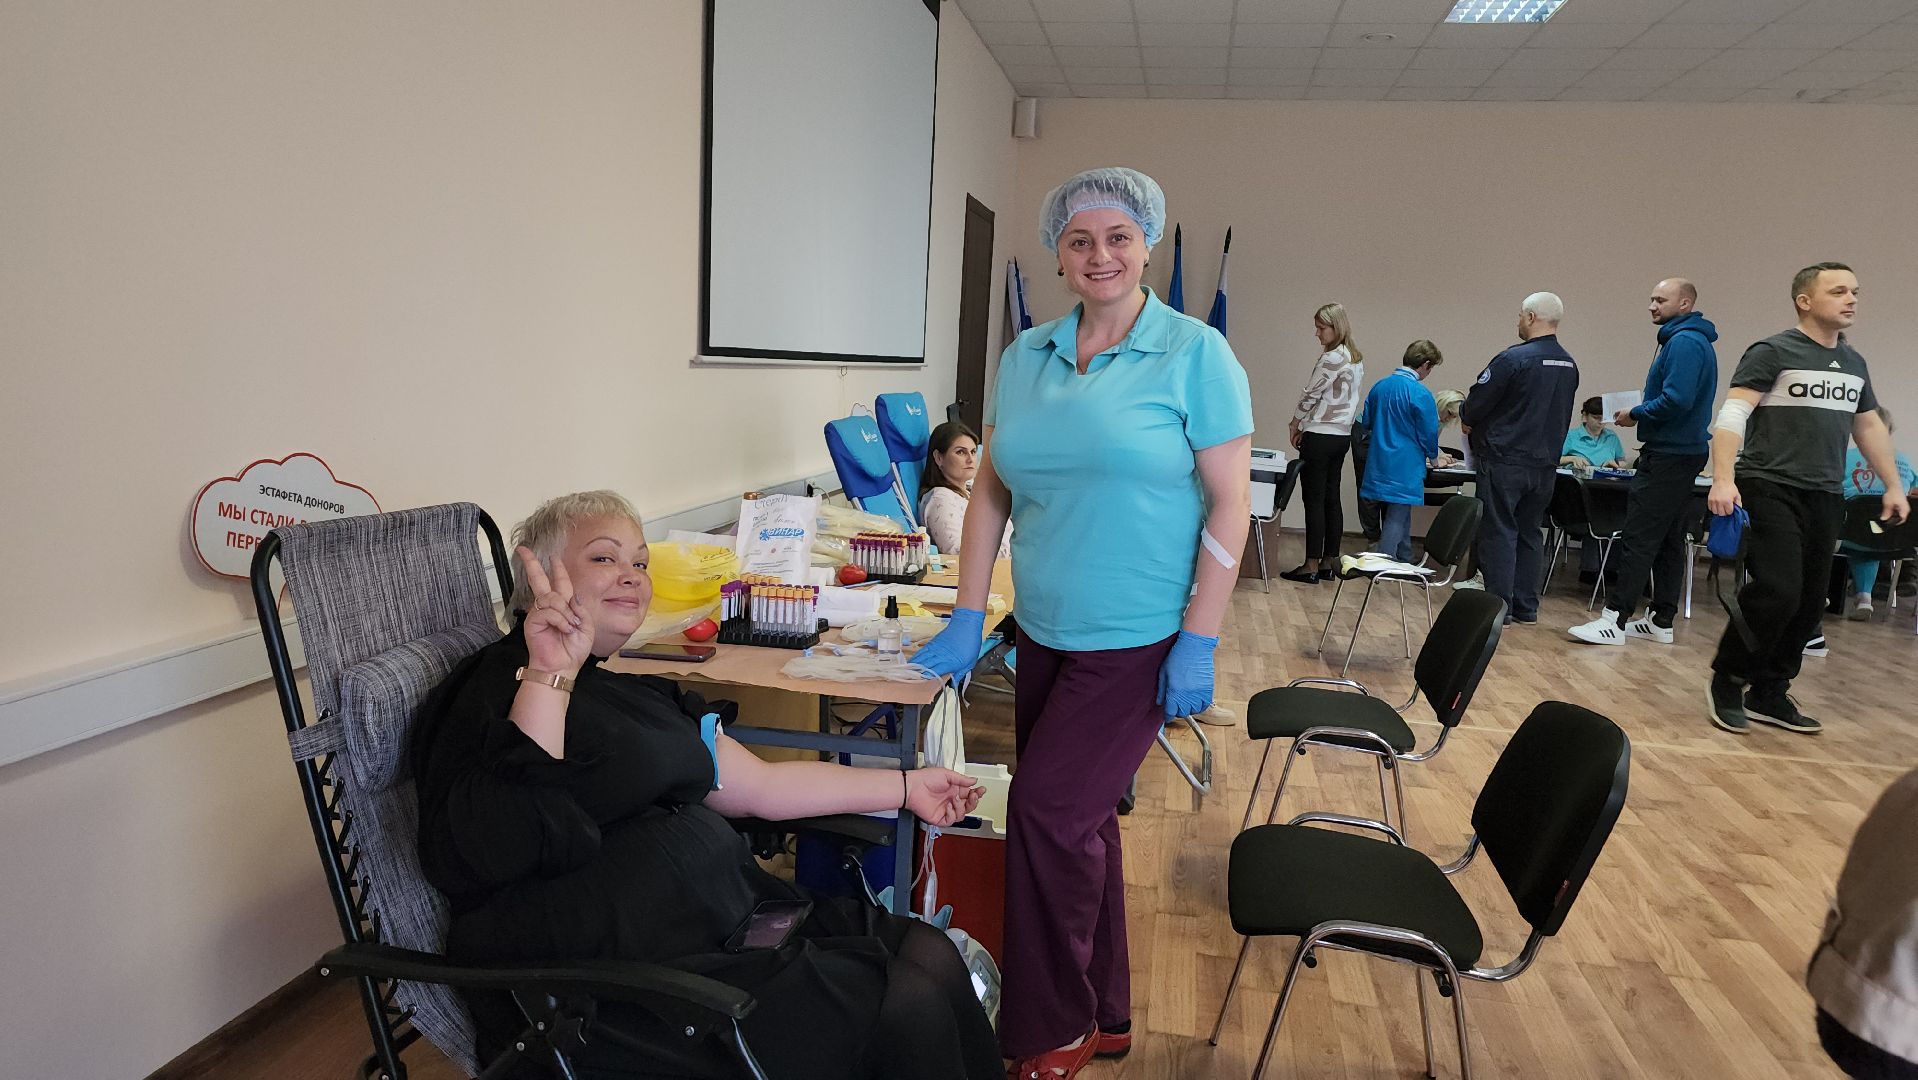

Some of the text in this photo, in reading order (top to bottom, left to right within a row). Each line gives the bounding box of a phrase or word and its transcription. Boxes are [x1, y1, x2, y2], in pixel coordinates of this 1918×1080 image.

[259, 485, 345, 515] ЭСТАФЕТА ДОНОРОВ
[218, 502, 246, 521] МЫ
[250, 509, 295, 528] СТАЛИ
[768, 527, 804, 537] ВИНАР
